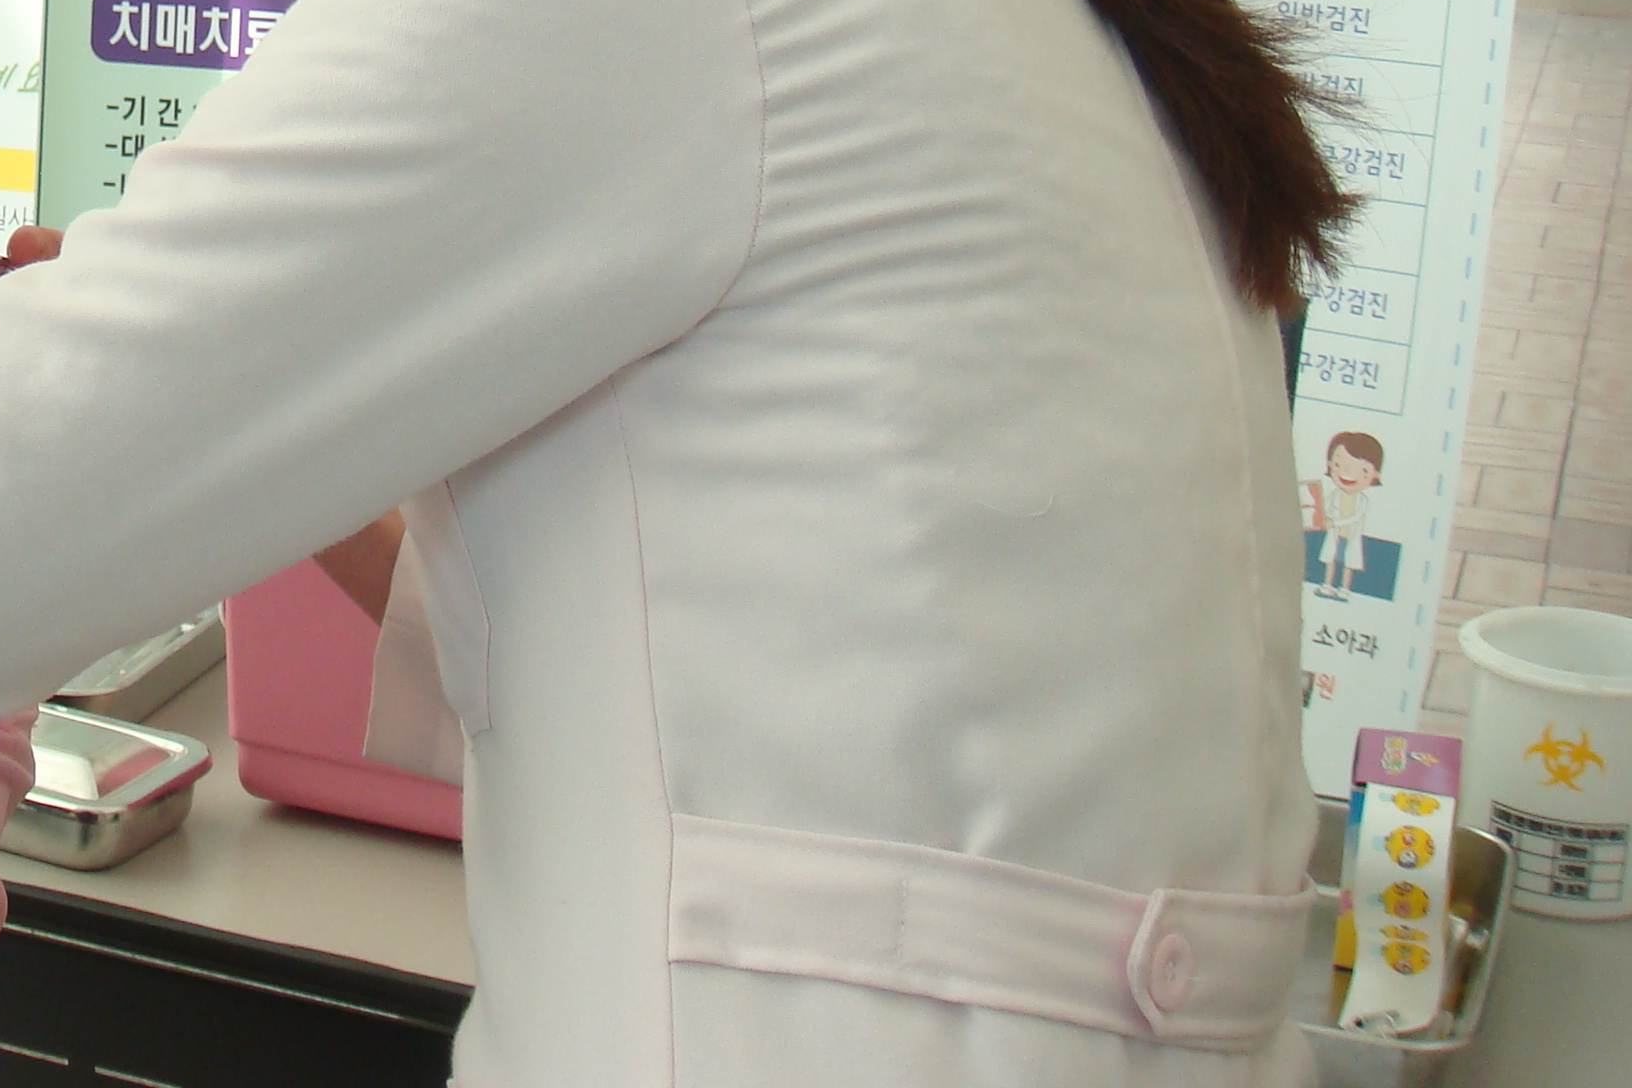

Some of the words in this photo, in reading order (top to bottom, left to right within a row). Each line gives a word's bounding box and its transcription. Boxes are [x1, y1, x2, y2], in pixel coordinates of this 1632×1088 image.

[157, 97, 182, 128] 간
[1299, 351, 1381, 390] 구강검진
[1311, 622, 1380, 660] 소아과
